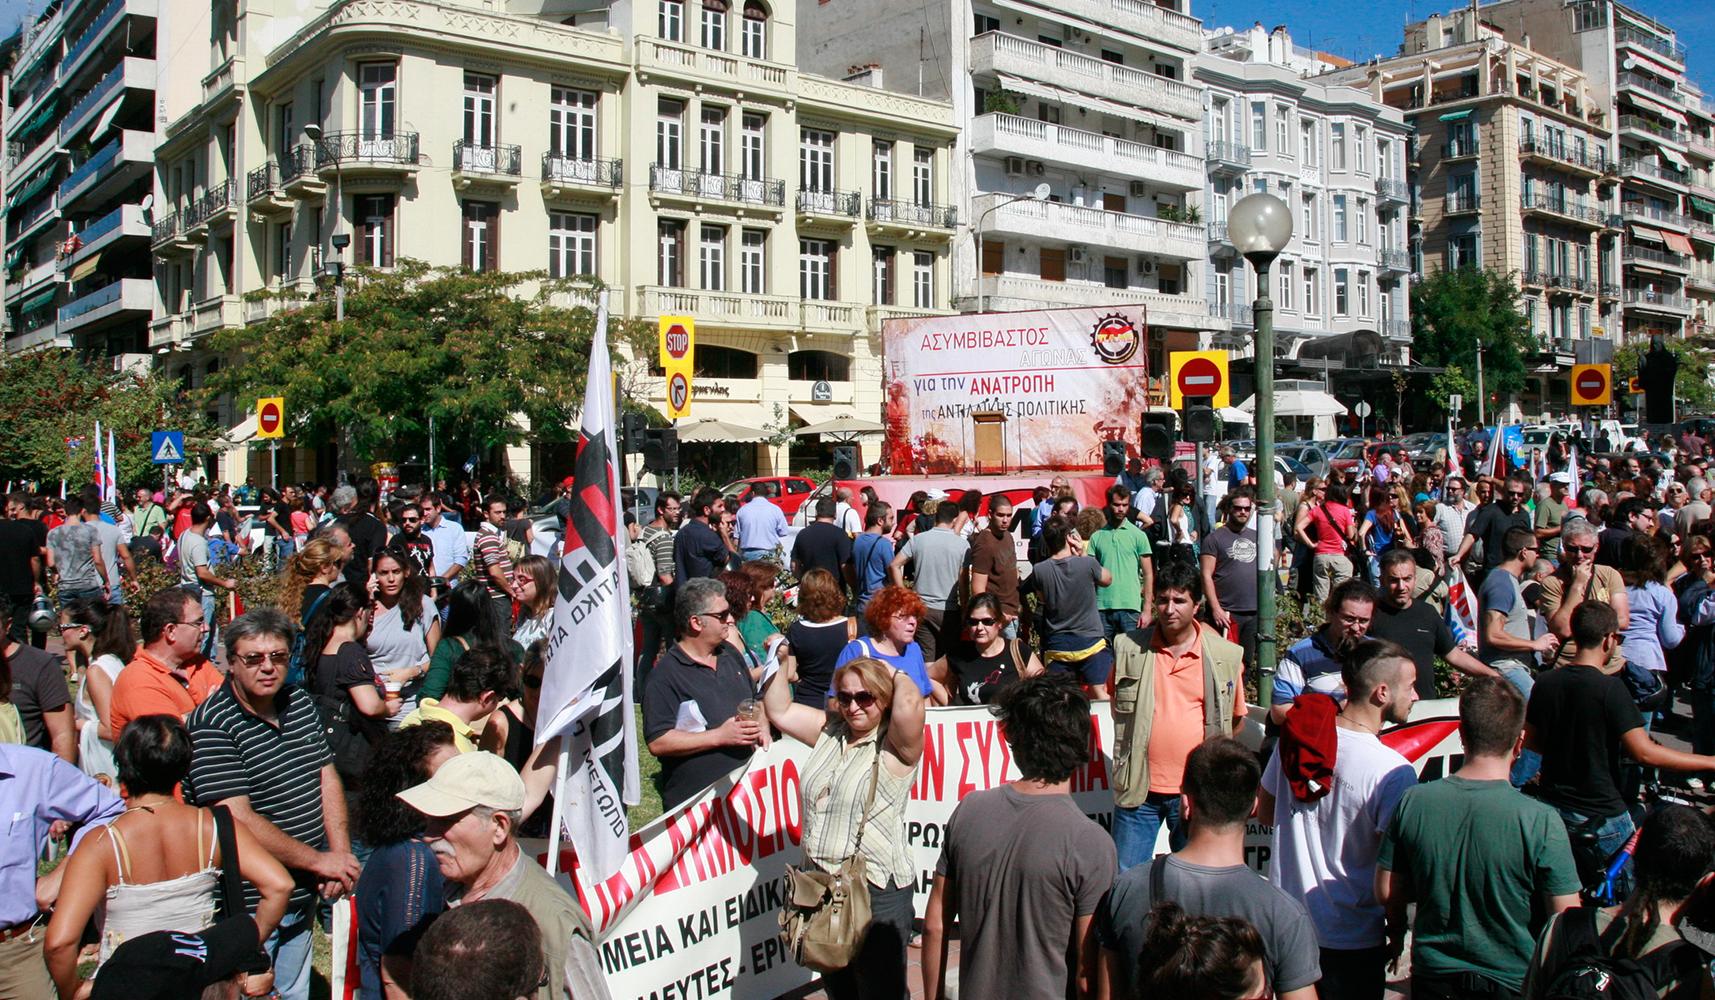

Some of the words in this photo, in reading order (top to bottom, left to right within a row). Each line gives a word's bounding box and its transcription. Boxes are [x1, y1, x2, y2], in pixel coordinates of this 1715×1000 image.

[667, 333, 688, 351] STOP
[921, 327, 1049, 351] ΑΣΥΜΒΙΒΑΣΤΟΣ
[1019, 349, 1088, 367] ΑΓΩΝΑΣ
[913, 377, 936, 396] για
[940, 376, 965, 391] την
[970, 374, 1055, 395] ΑΝΑΤΡΟΠΗ
[1017, 399, 1087, 417] ΠΟΛΙΤΙΚΗΣ
[582, 748, 626, 839] ΜΕΤΩΠΟ
[598, 924, 675, 975] ΜΕΙΑ
[677, 904, 719, 949] ΚΑΙ
